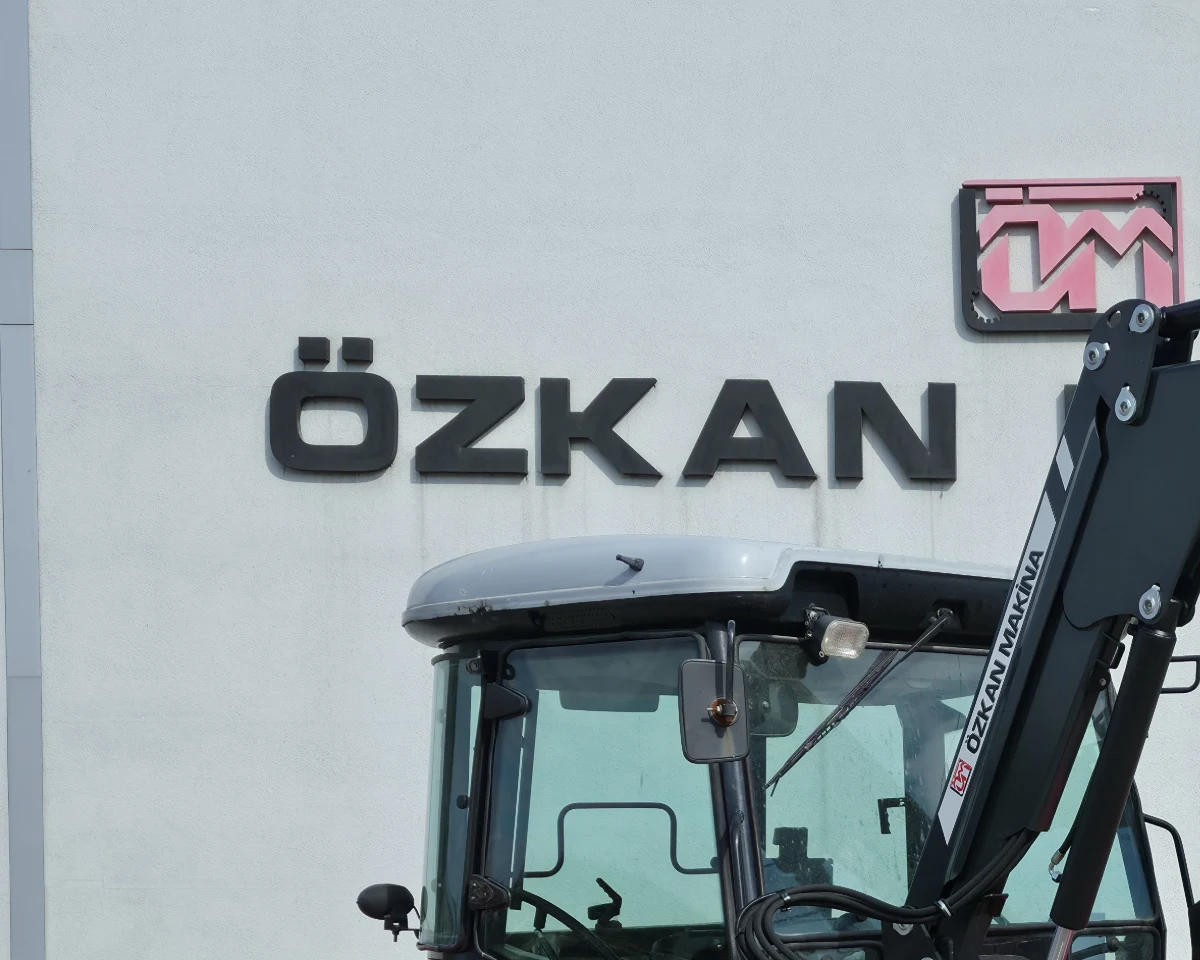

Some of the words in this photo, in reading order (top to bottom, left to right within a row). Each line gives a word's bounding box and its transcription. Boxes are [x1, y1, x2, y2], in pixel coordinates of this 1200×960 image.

[269, 336, 957, 482] ÖZKAN
[964, 658, 1007, 755] ÖZKAN
[997, 549, 1045, 658] MAKİNA
